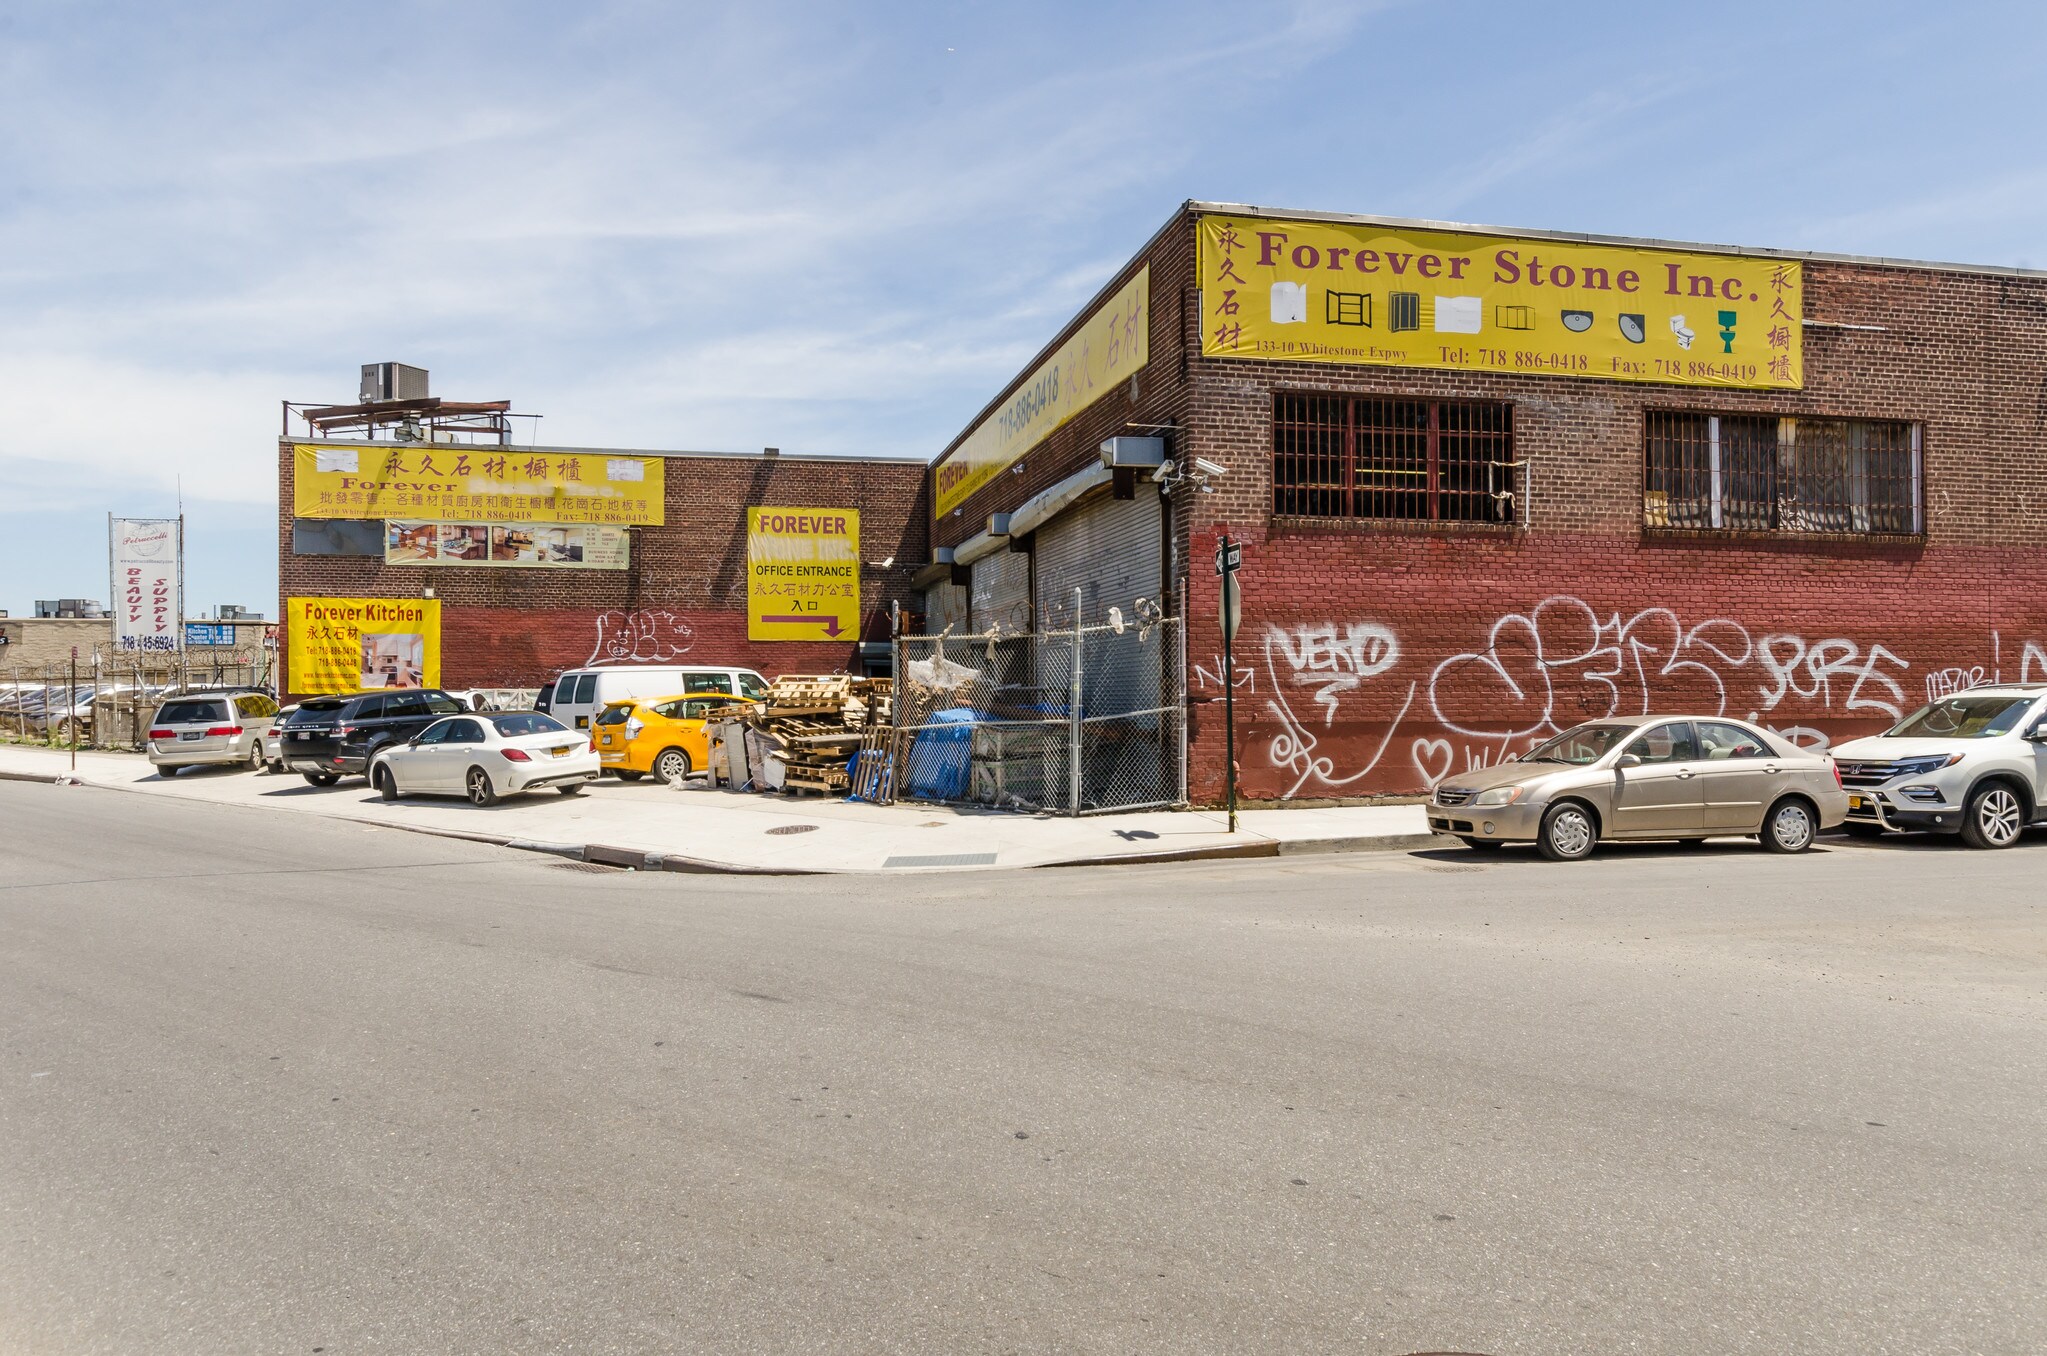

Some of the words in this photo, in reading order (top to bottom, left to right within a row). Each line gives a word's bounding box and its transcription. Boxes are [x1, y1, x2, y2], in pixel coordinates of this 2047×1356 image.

[1256, 231, 1471, 280] Forever
[1494, 250, 1640, 293] Stone
[1663, 263, 1759, 302] Inc.
[1214, 222, 1247, 350] 永久石材
[1255, 340, 1294, 353] 133-10
[1299, 342, 1365, 357] Whitestone
[1369, 346, 1408, 361] Expwy
[1439, 346, 1470, 365] Tel:
[1478, 348, 1507, 366] 718
[1514, 350, 1588, 370] 886-0418
[1612, 356, 1646, 374] Fax:
[1654, 359, 1681, 376] 718
[1688, 360, 1757, 379] 886-0419
[999, 365, 1059, 448] 718-886-0418
[340, 477, 458, 492] Forever
[341, 508, 382, 517] Whitestone
[441, 509, 459, 519] Tel:
[464, 510, 482, 519] 718
[486, 510, 532, 520] 886-0418
[556, 512, 579, 521] Fax:
[583, 512, 600, 521] 718
[604, 513, 649, 522] 886-0419
[760, 515, 846, 535] FOREVER
[122, 531, 168, 545] Petruccelli
[756, 565, 793, 576] OFFICE
[796, 566, 852, 577] ENTRANCE
[126, 568, 143, 622] BEAUTY
[152, 578, 168, 632] SUPPLY
[305, 603, 362, 621] Forever
[366, 605, 423, 622] Kitchen
[791, 600, 818, 612] 入口
[122, 636, 135, 650] 718
[306, 626, 359, 641] 永久石材
